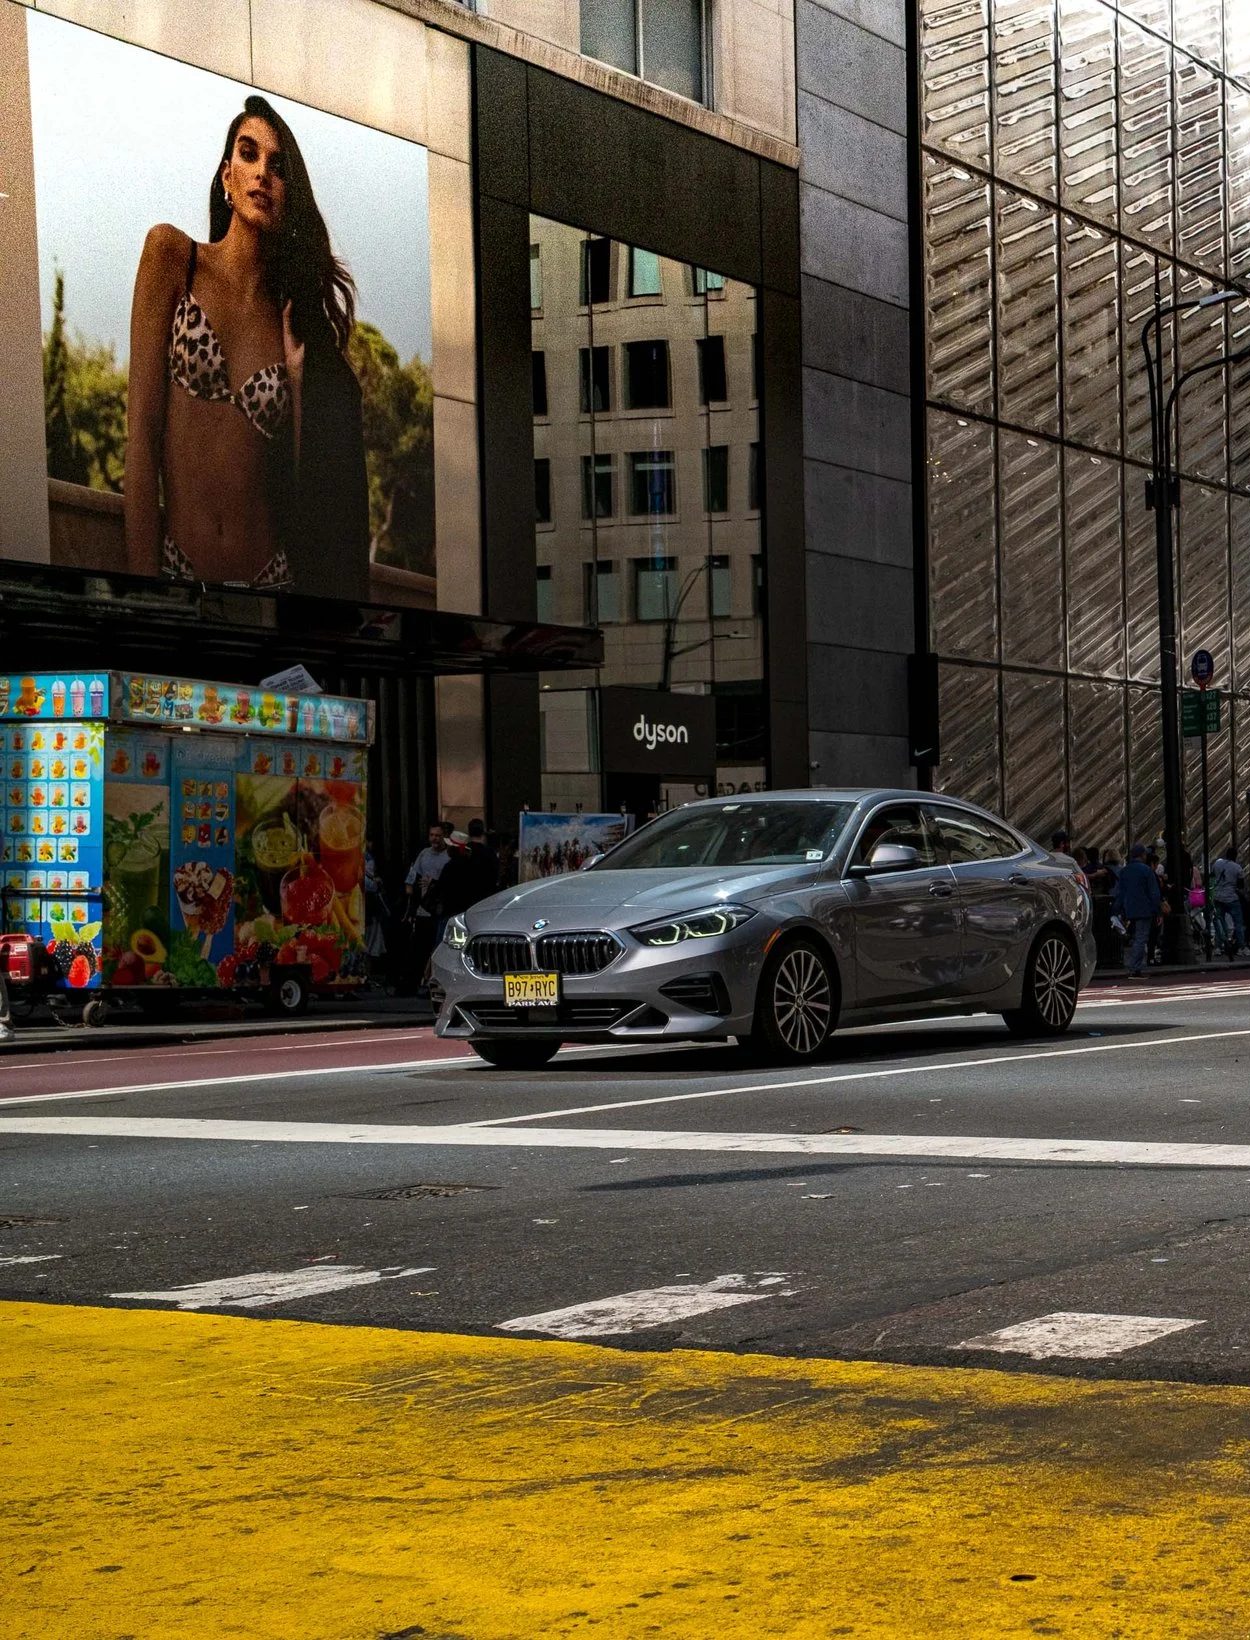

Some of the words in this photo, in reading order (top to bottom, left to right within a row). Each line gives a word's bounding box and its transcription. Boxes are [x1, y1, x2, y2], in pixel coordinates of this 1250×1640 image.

[633, 714, 688, 750] dyson
[508, 981, 528, 997] B97
[535, 980, 555, 997] RYC
